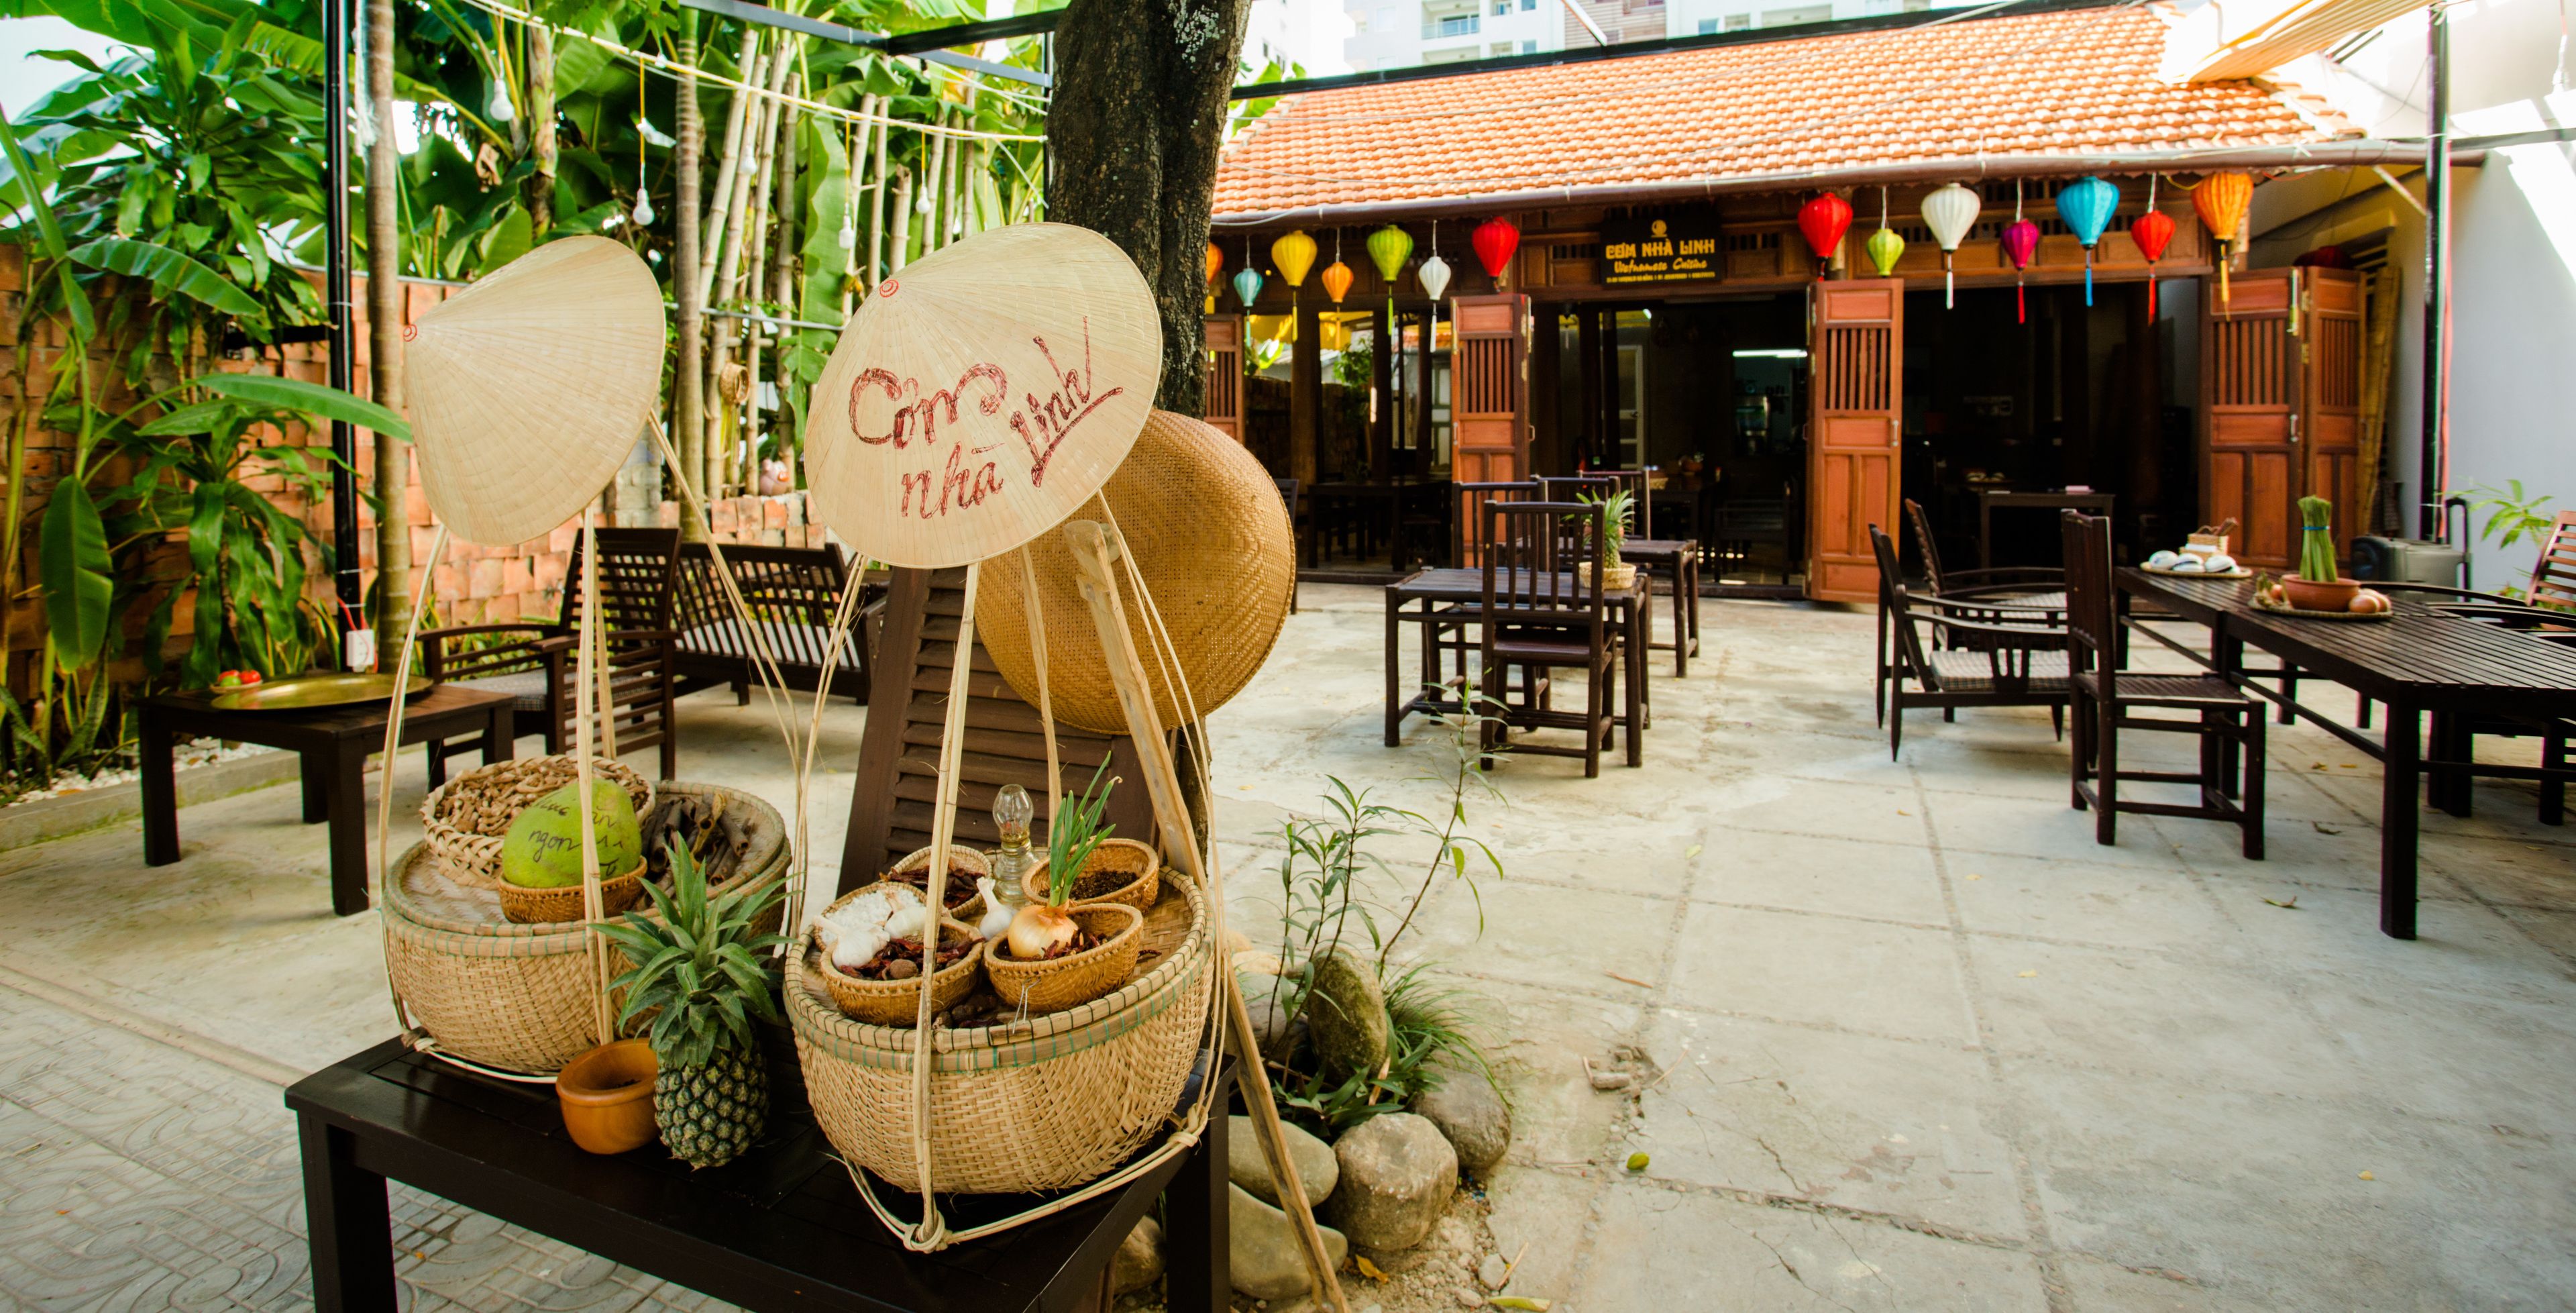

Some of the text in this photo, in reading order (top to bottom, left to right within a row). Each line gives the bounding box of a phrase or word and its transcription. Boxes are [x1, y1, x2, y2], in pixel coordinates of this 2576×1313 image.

[1605, 238, 1715, 259] CƠM NHÀ LINH
[1614, 258, 1707, 274] Vietnamese Cuisine
[529, 830, 582, 863] ngon
